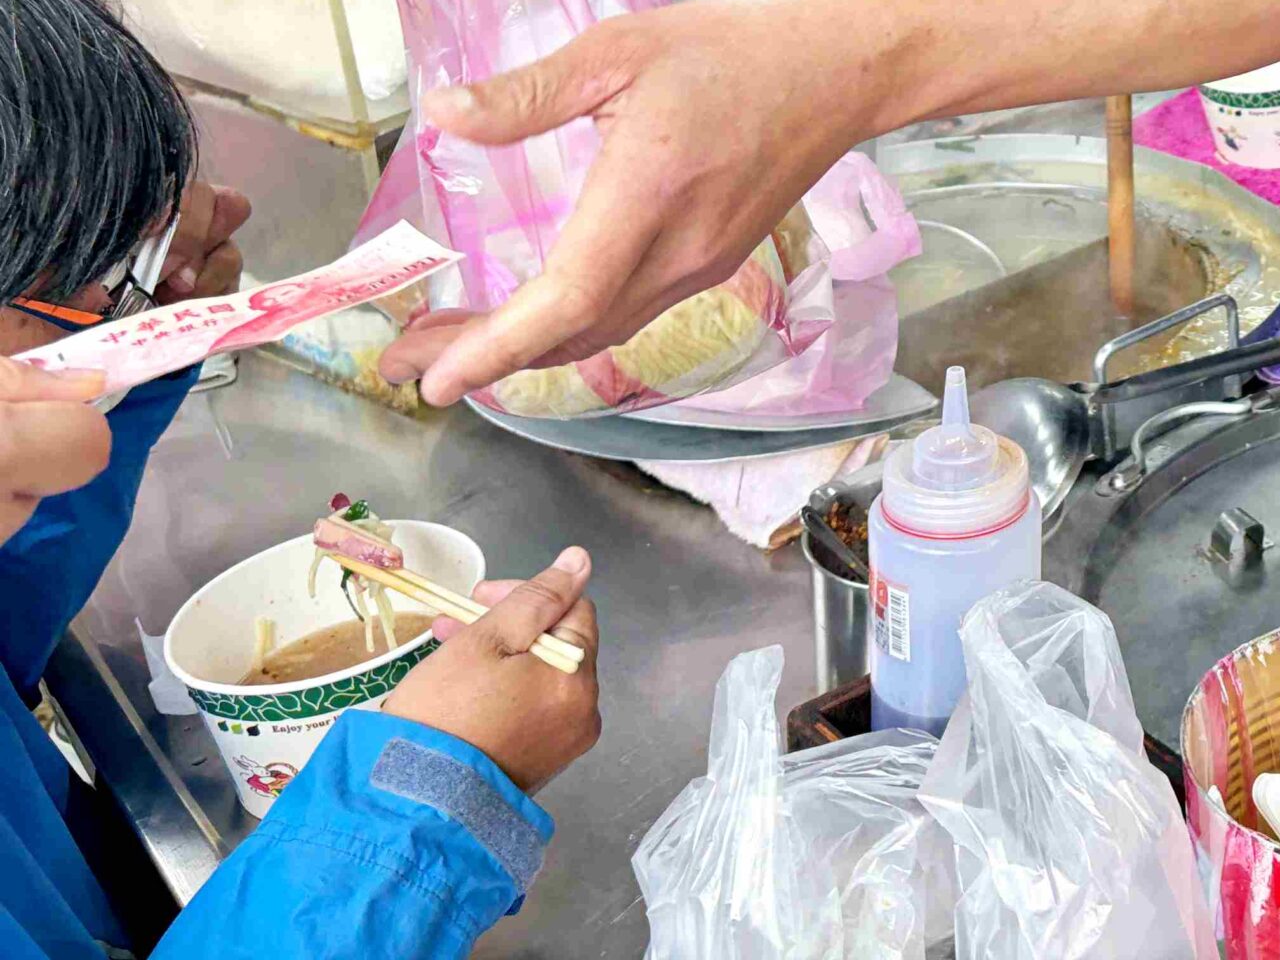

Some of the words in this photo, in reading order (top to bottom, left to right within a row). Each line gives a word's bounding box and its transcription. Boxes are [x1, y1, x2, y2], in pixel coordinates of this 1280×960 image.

[99, 302, 236, 345] 中華民國
[131, 318, 218, 347] 中央銀行
[271, 724, 303, 734] Enjoy
[306, 719, 331, 731] your
